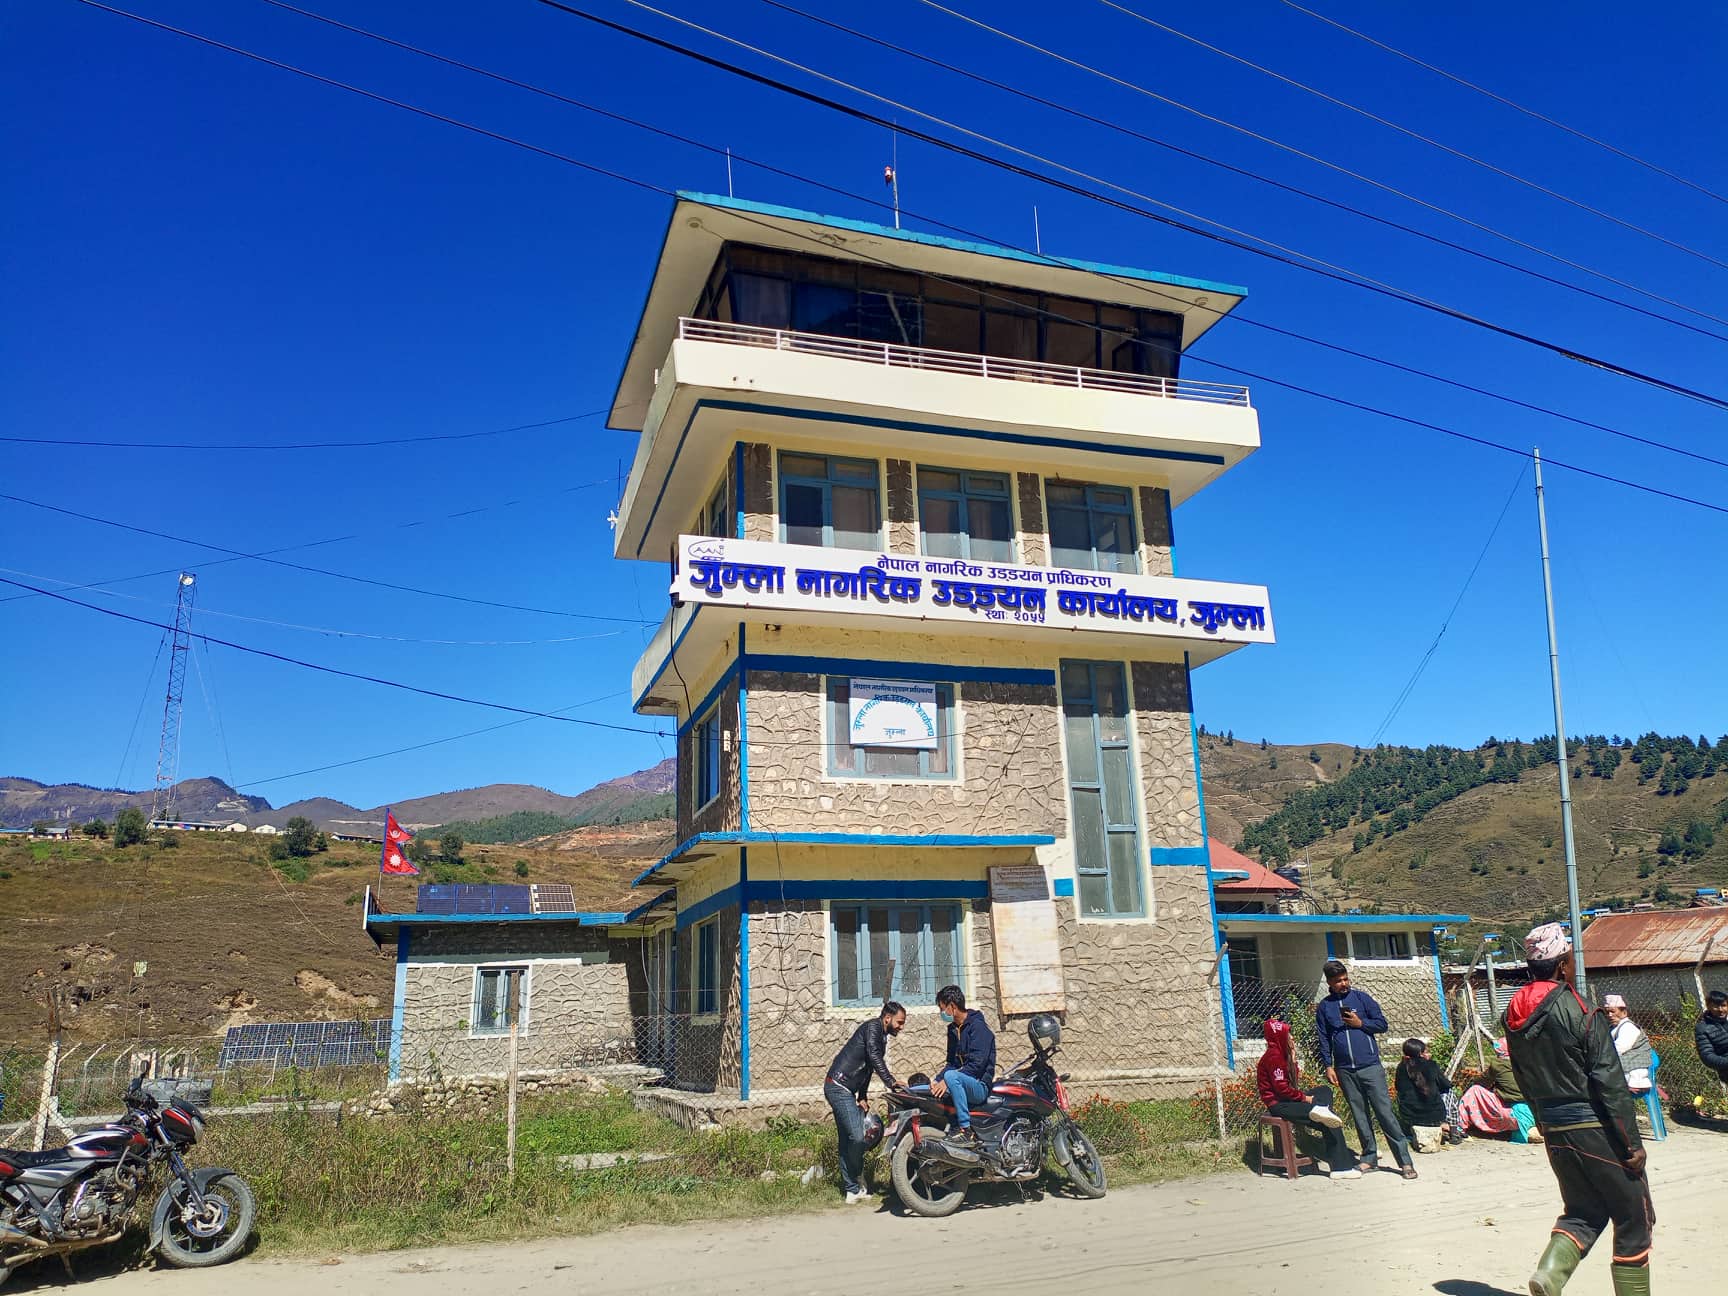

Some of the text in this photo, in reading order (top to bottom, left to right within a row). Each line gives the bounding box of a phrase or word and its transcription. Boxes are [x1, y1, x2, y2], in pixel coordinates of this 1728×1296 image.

[877, 555, 920, 572] नेपाल
[925, 560, 983, 577] नागरिक
[1046, 570, 1112, 588] प्राधिकरण
[689, 560, 786, 596] जुम्ला
[795, 566, 922, 602] नागरिक
[1188, 601, 1265, 633] जुम्ला
[1014, 611, 1045, 623] २०५५
